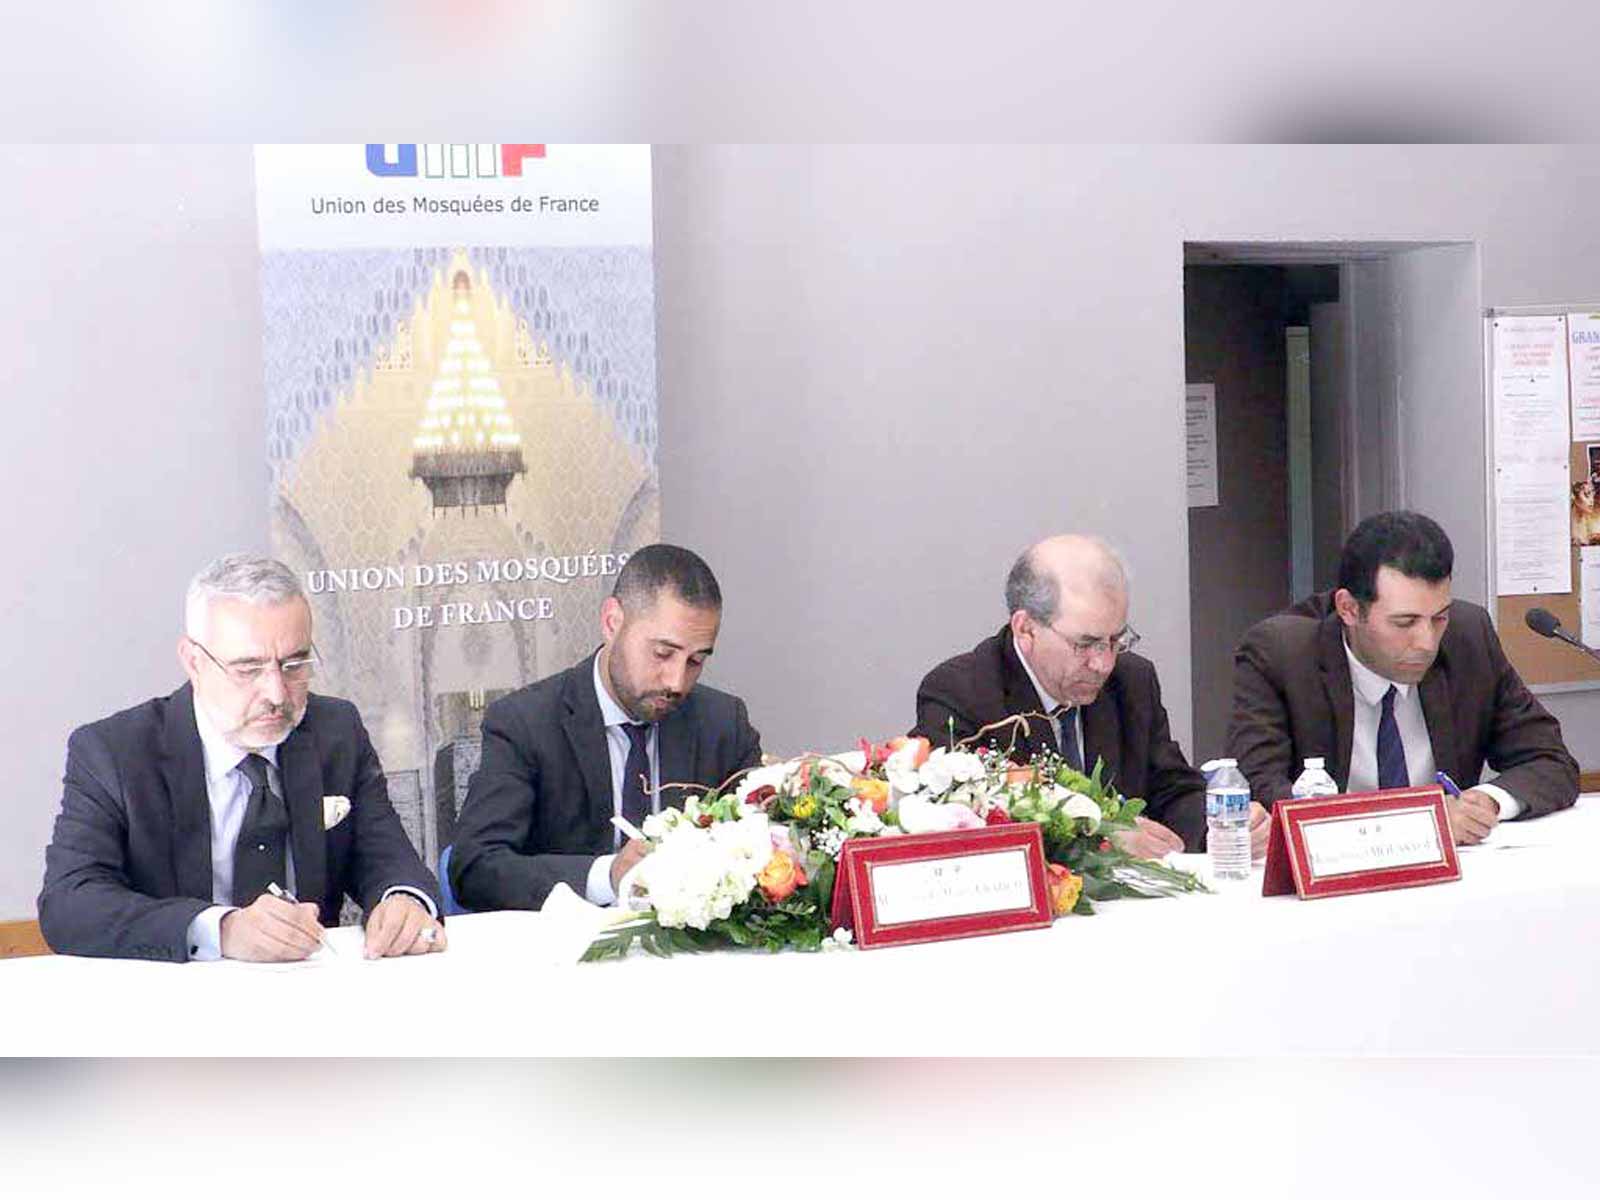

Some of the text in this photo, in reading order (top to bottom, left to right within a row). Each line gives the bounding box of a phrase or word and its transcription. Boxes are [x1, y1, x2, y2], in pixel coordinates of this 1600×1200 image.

[311, 195, 600, 215] Union des Mosquées de France
[306, 550, 631, 594] UNION DES MOSQUÉES
[393, 597, 554, 630] DE FRANCE
